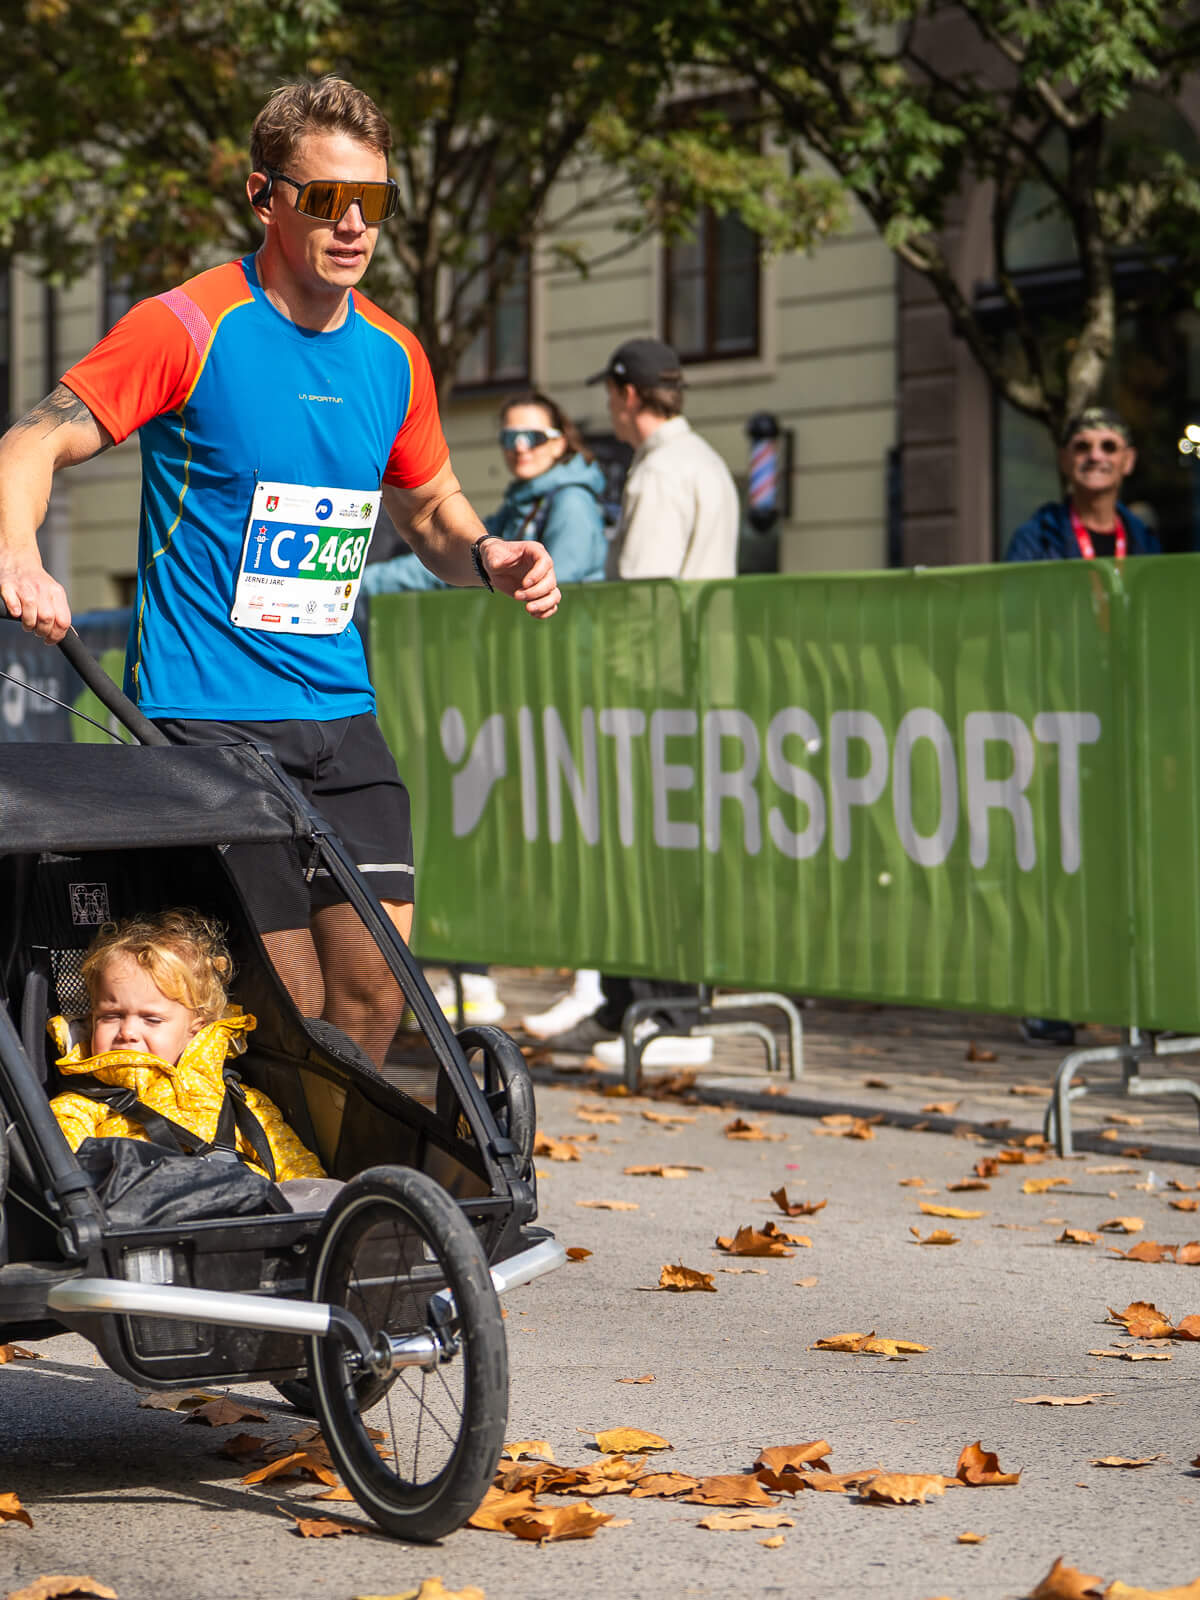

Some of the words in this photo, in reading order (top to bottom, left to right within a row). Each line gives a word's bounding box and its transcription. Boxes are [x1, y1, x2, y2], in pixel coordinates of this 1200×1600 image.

[308, 394, 344, 403] SPORTIVA
[270, 530, 296, 569] C
[298, 533, 366, 573] 2468
[245, 576, 269, 584] JERNEJ
[518, 704, 1101, 874] INTERSPORT
